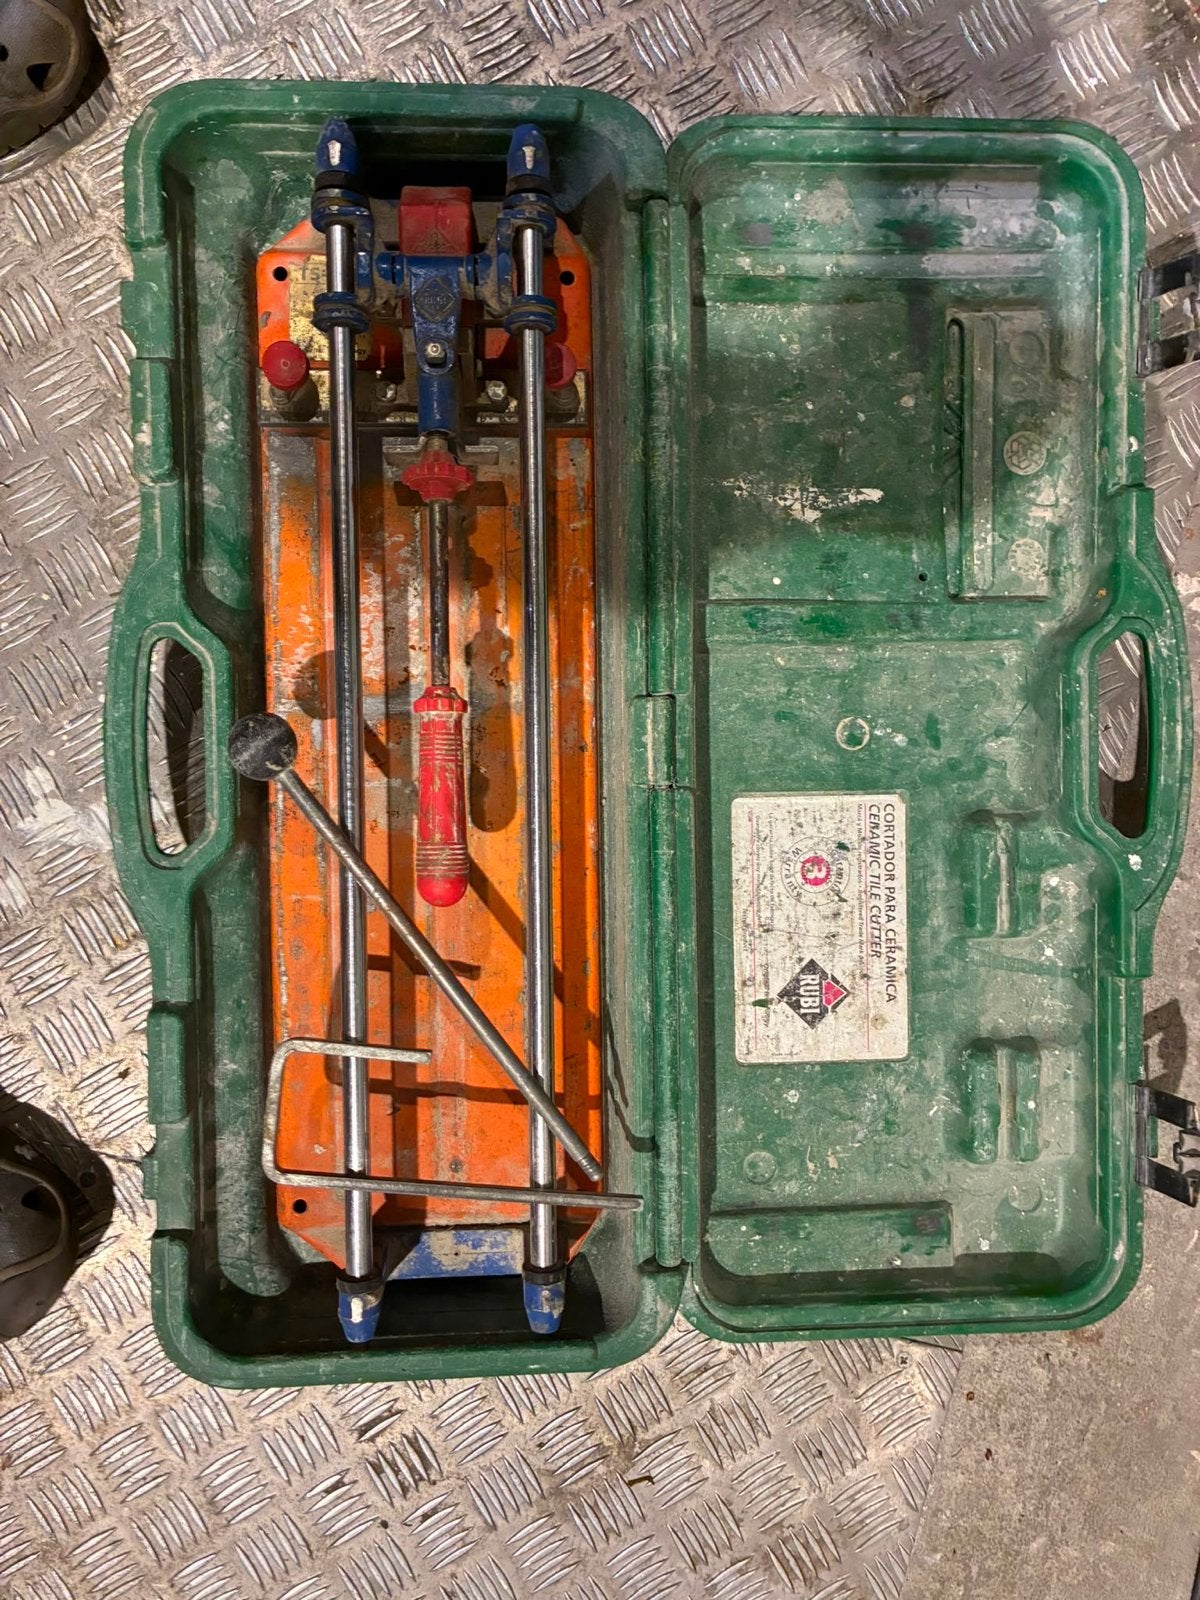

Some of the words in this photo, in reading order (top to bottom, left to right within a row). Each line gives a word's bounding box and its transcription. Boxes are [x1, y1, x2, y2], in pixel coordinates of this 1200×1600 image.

[869, 804, 880, 869] CERAMIC
[884, 803, 895, 882] CORTADOR
[870, 873, 881, 901] TILE
[885, 886, 896, 923] PARA
[870, 905, 882, 958] CUTTER
[885, 928, 897, 1003] CERAMICA
[798, 974, 820, 1014] RUBI
